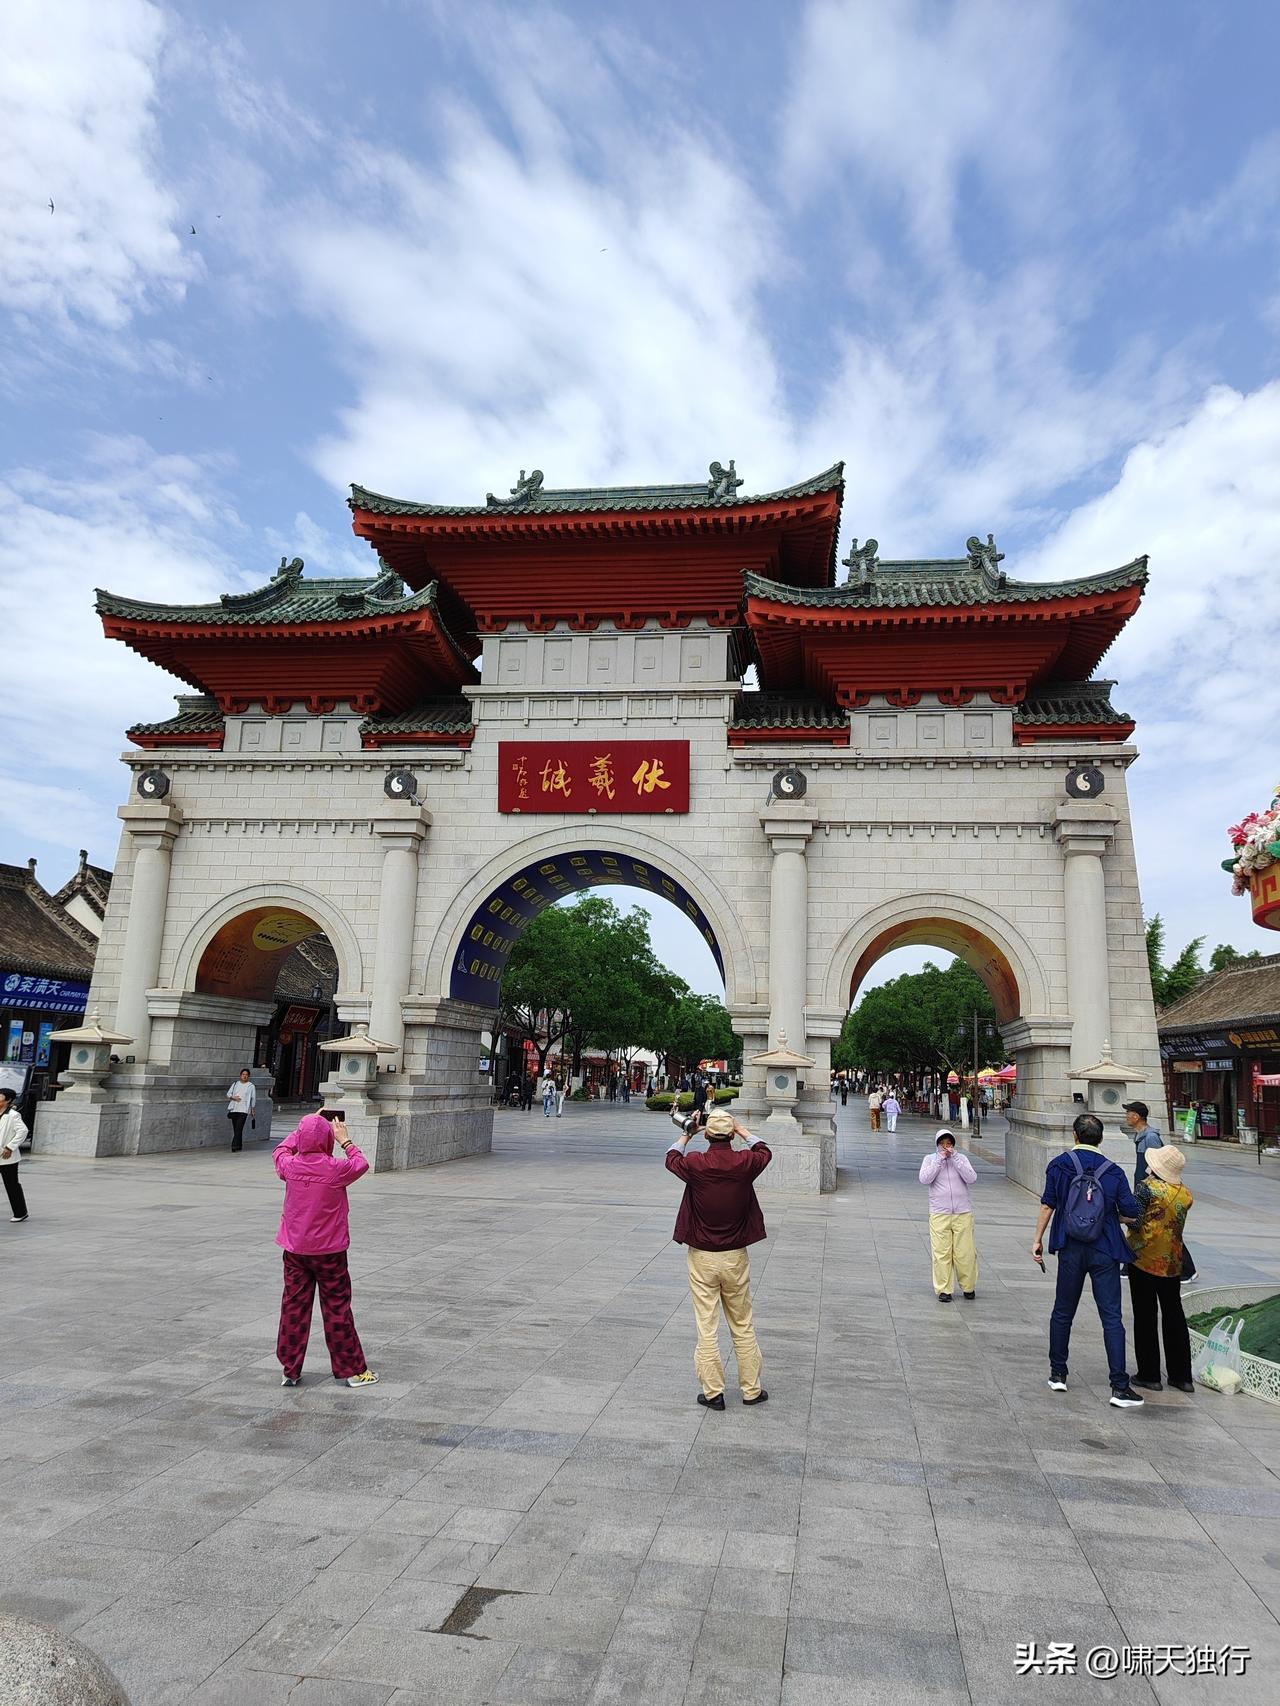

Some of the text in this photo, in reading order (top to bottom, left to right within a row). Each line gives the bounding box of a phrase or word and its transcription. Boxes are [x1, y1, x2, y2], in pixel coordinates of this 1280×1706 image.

[539, 753, 671, 800] 伏羲城
[18, 976, 62, 995] 茶满天
